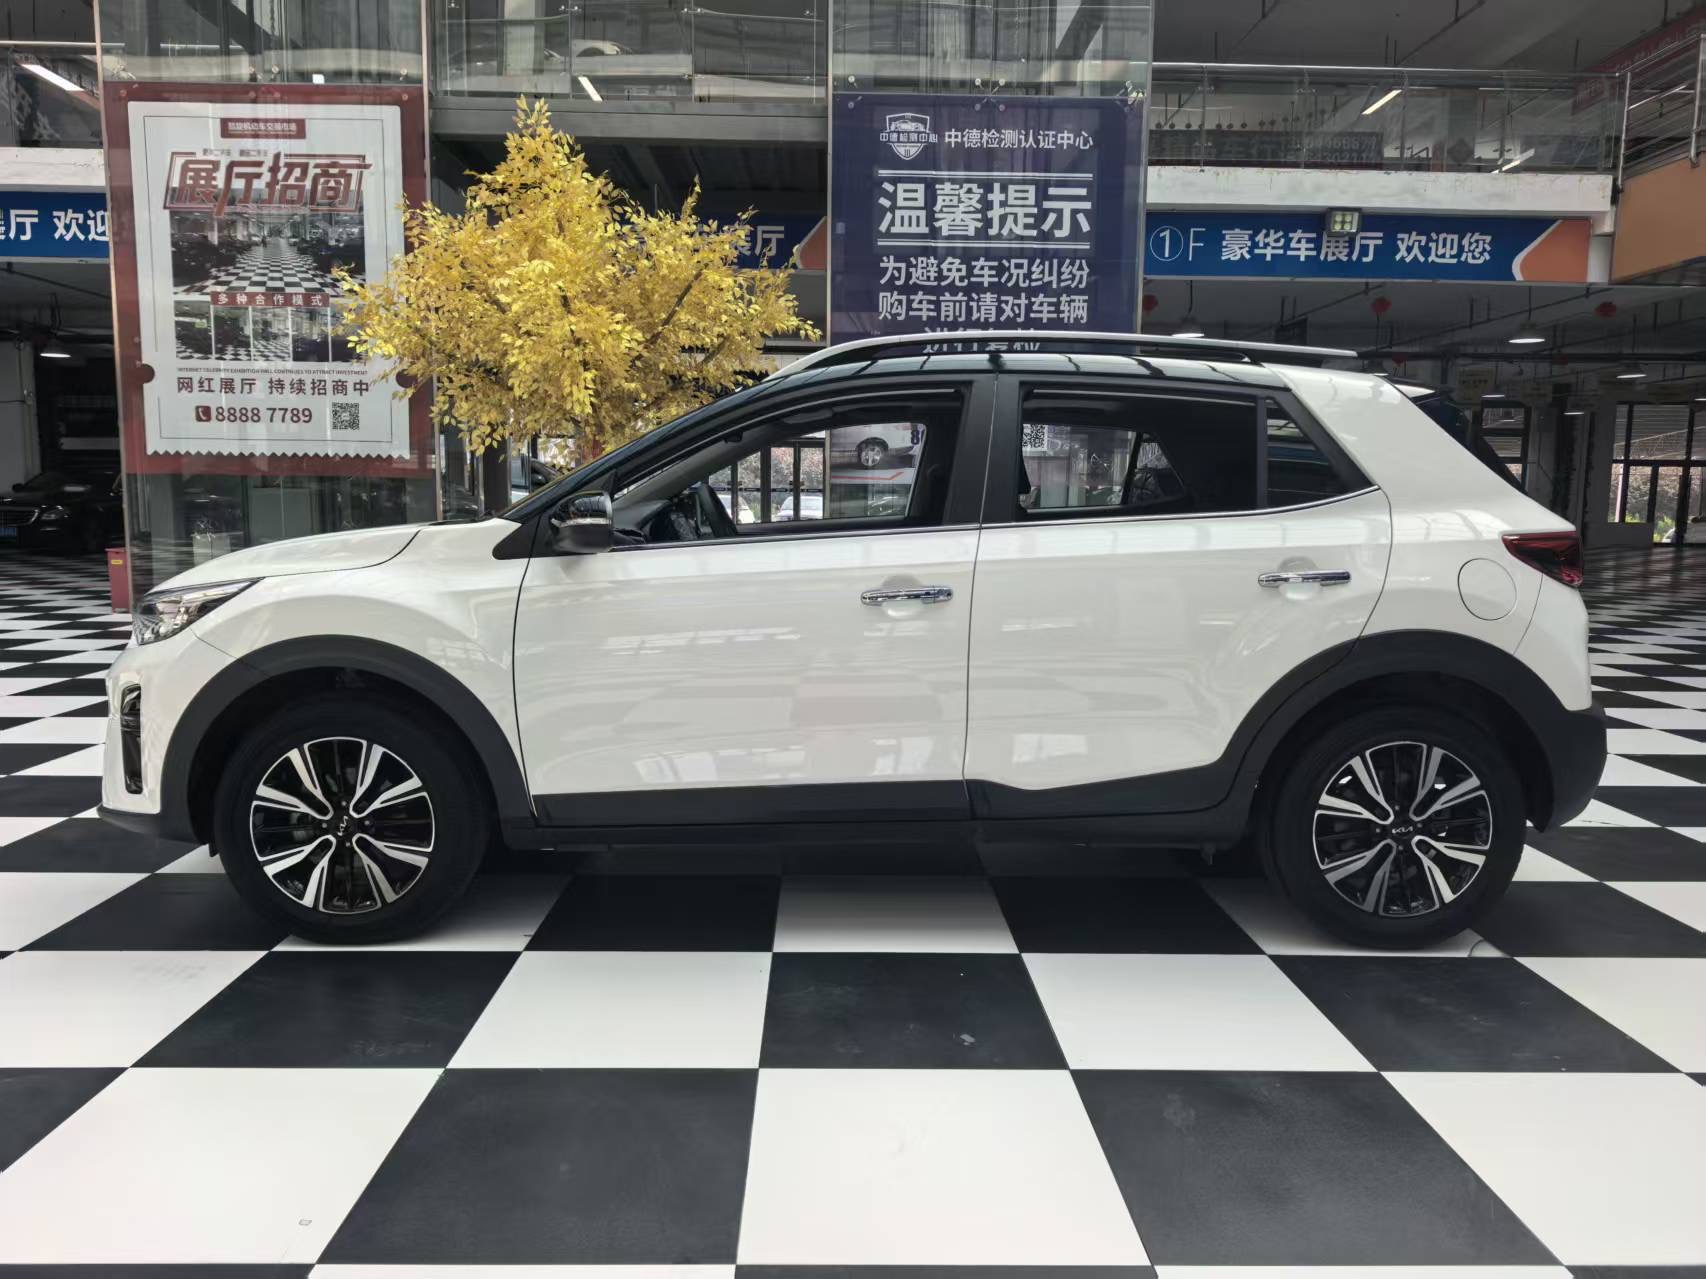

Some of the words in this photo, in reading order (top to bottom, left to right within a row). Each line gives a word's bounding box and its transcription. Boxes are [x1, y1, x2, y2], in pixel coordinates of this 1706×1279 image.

[944, 128, 1093, 150] 中德检测认证中心
[177, 152, 373, 217] 展厅招商
[0, 209, 39, 241] 厅
[878, 182, 1092, 238] 温馨提示
[1221, 228, 1384, 263] 豪华车展厅
[1395, 231, 1492, 265] 欢迎您
[879, 255, 1090, 288] 为避免车况纠纷
[218, 293, 323, 306] 多种合作模式
[878, 291, 1089, 323] 购车前请对车辆
[177, 377, 257, 394] 网红展厅
[268, 378, 370, 397] 持续招商中
[215, 406, 261, 424] 8888
[266, 407, 313, 424] 7789
